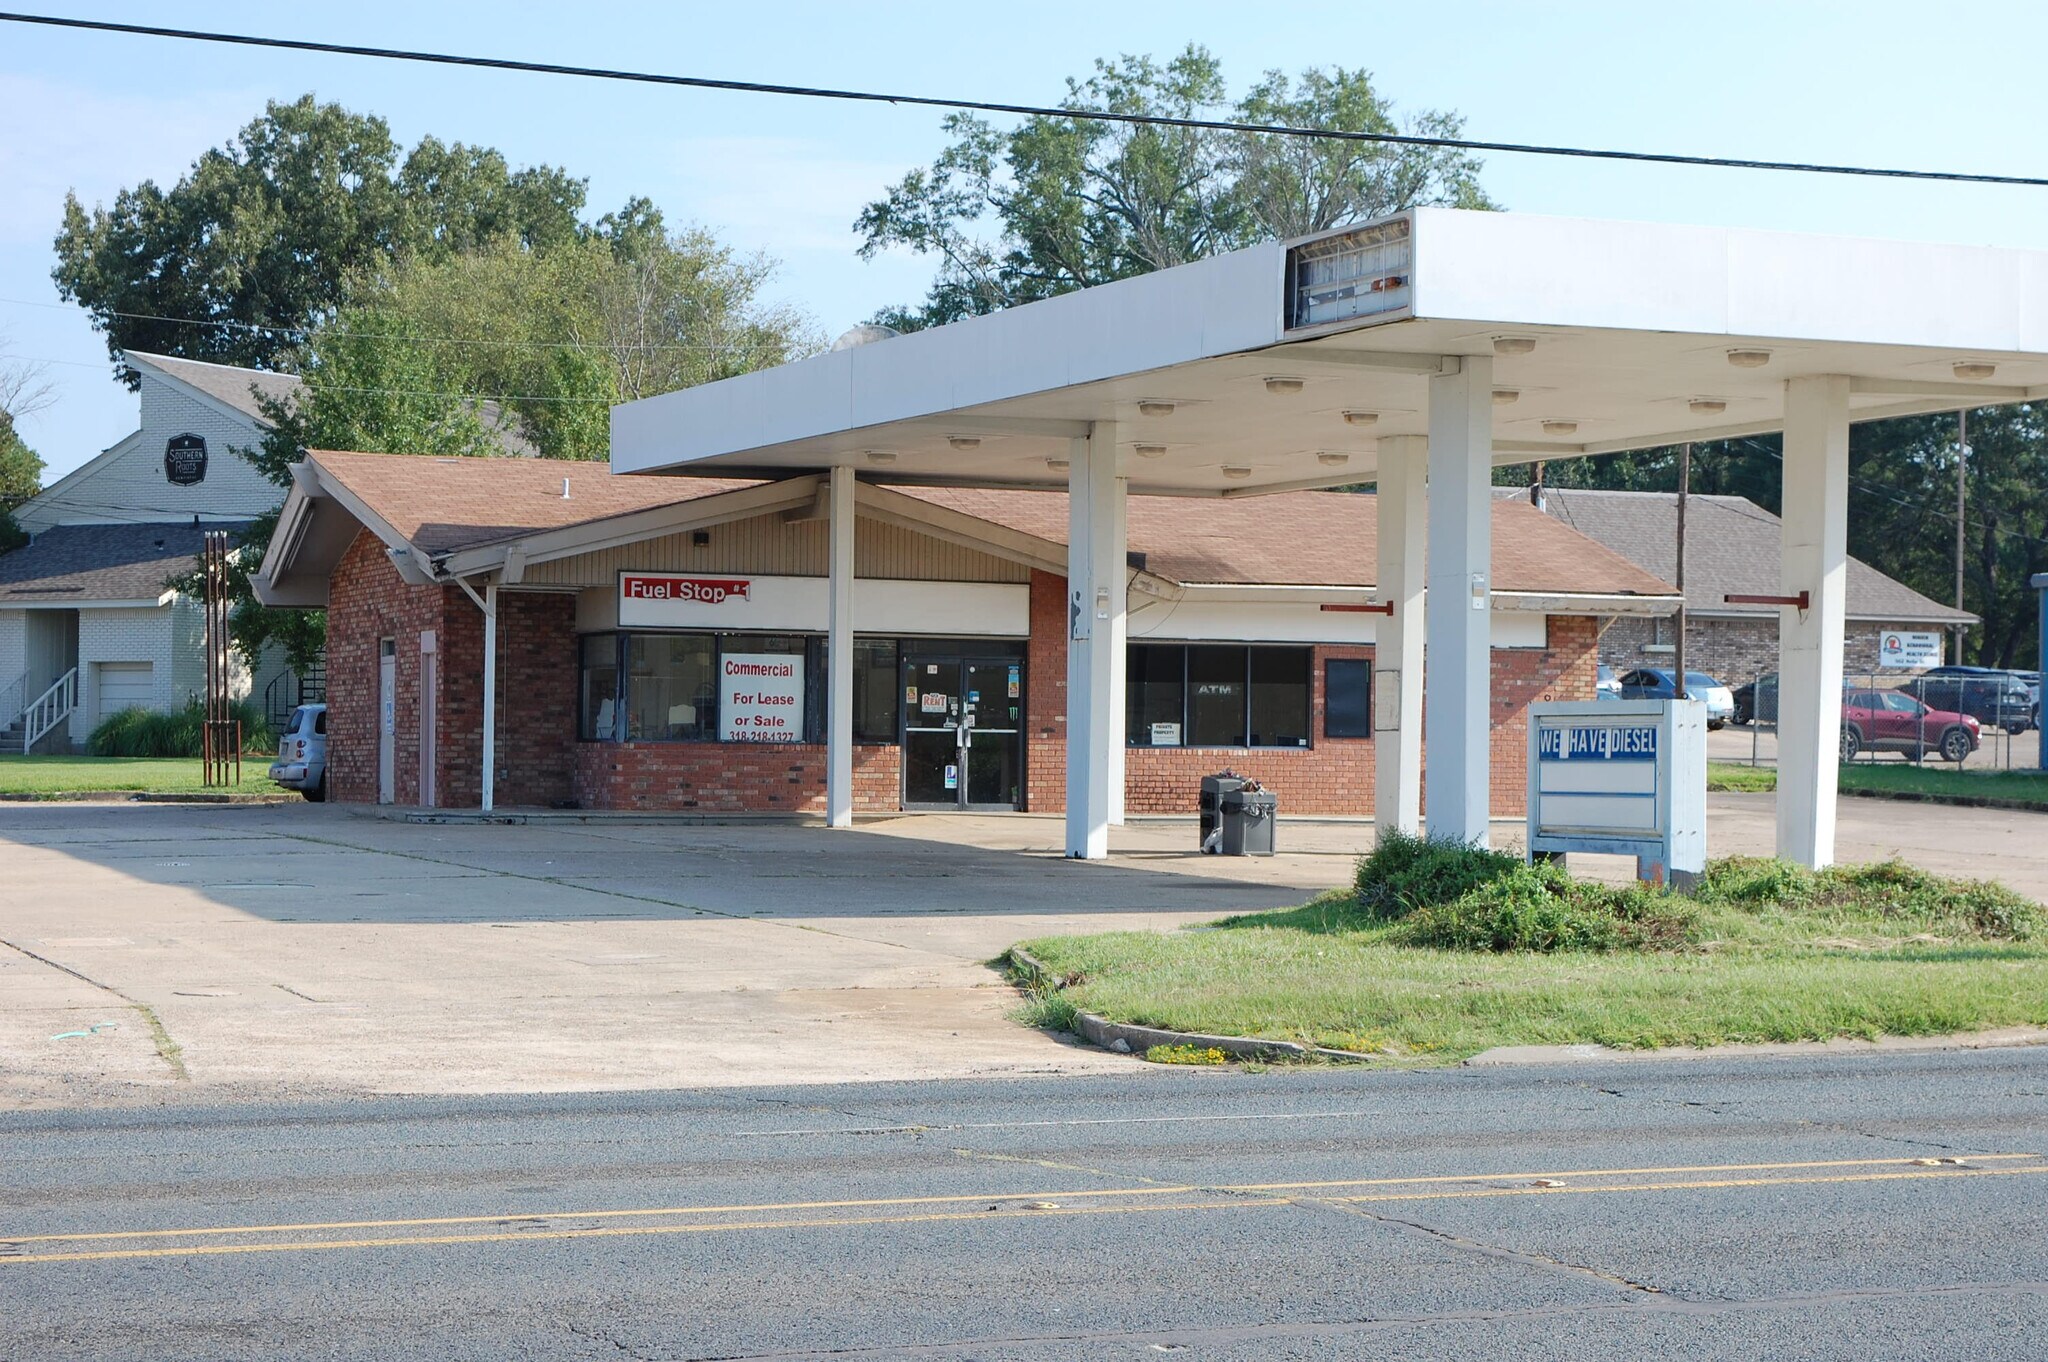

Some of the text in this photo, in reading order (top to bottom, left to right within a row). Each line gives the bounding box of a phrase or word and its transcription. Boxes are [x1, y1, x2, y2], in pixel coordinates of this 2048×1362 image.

[169, 450, 203, 462] SOUTHERN
[176, 461, 197, 473] ROOTS
[630, 580, 671, 599] Fuel
[679, 581, 726, 603] Stop
[725, 660, 793, 677] Commercial
[1198, 684, 1232, 694] ATM
[733, 692, 795, 705] For Lease
[734, 714, 785, 727] or Sale
[1540, 728, 1656, 753] WE HAVE DIESEL
